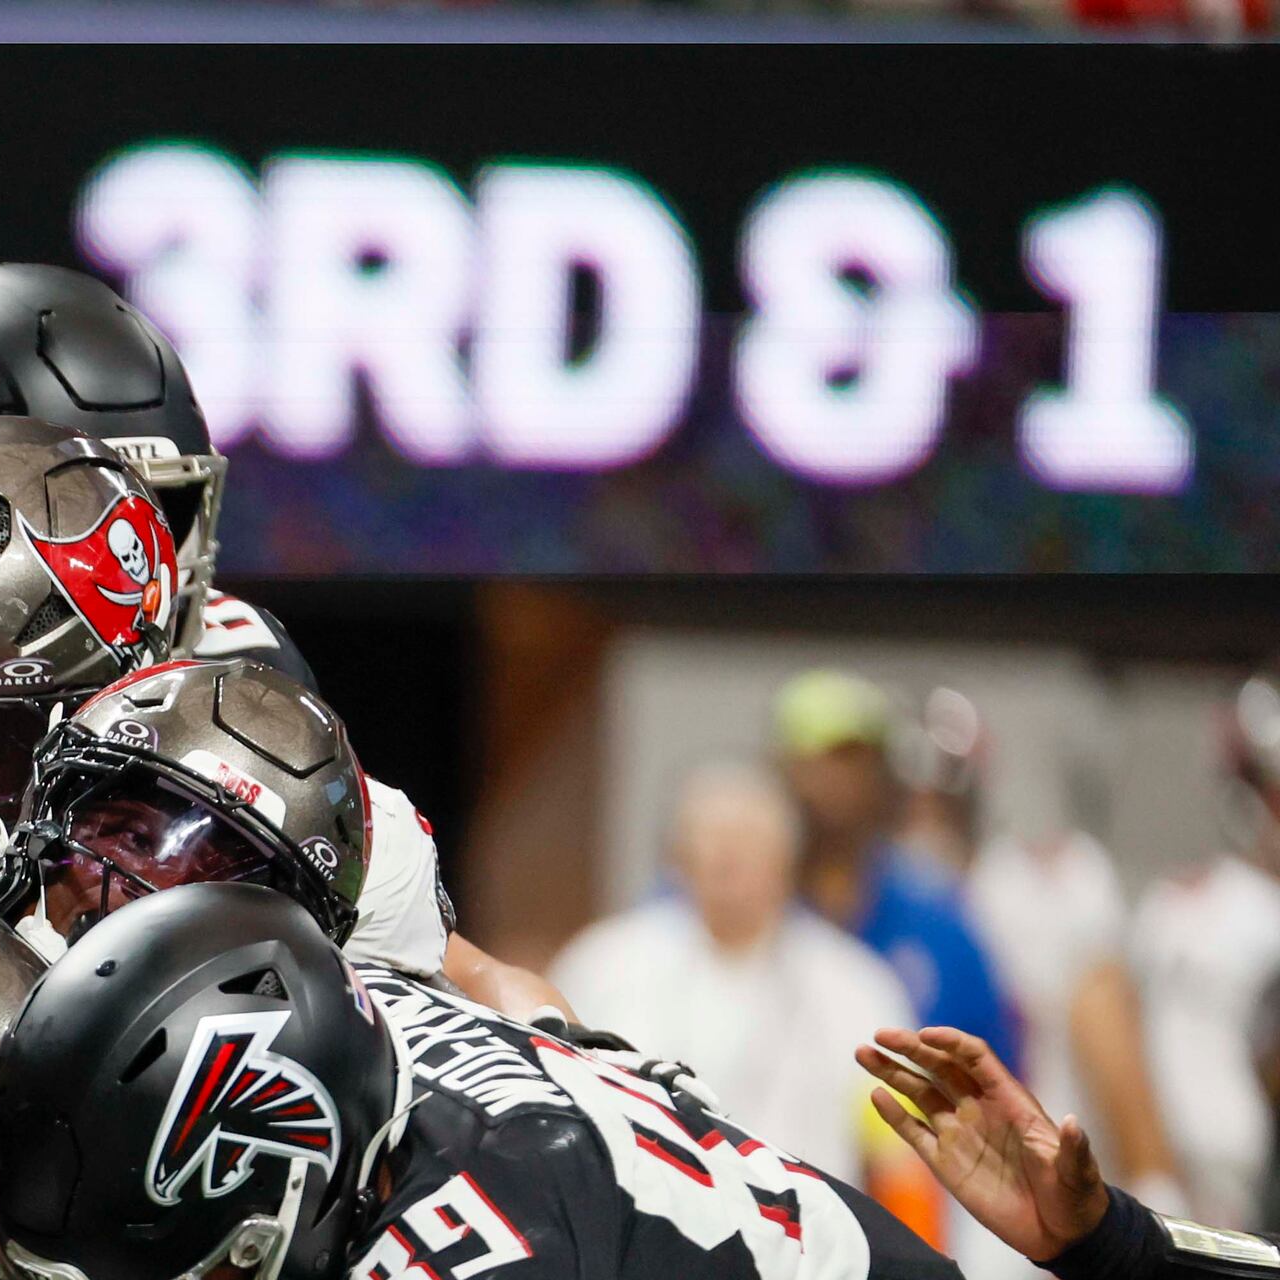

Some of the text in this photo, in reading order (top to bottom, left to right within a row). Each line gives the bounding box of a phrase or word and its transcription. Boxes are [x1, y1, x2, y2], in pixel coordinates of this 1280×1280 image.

[76, 142, 1196, 494] 3RD & 1
[301, 846, 335, 881] OAKLEY
